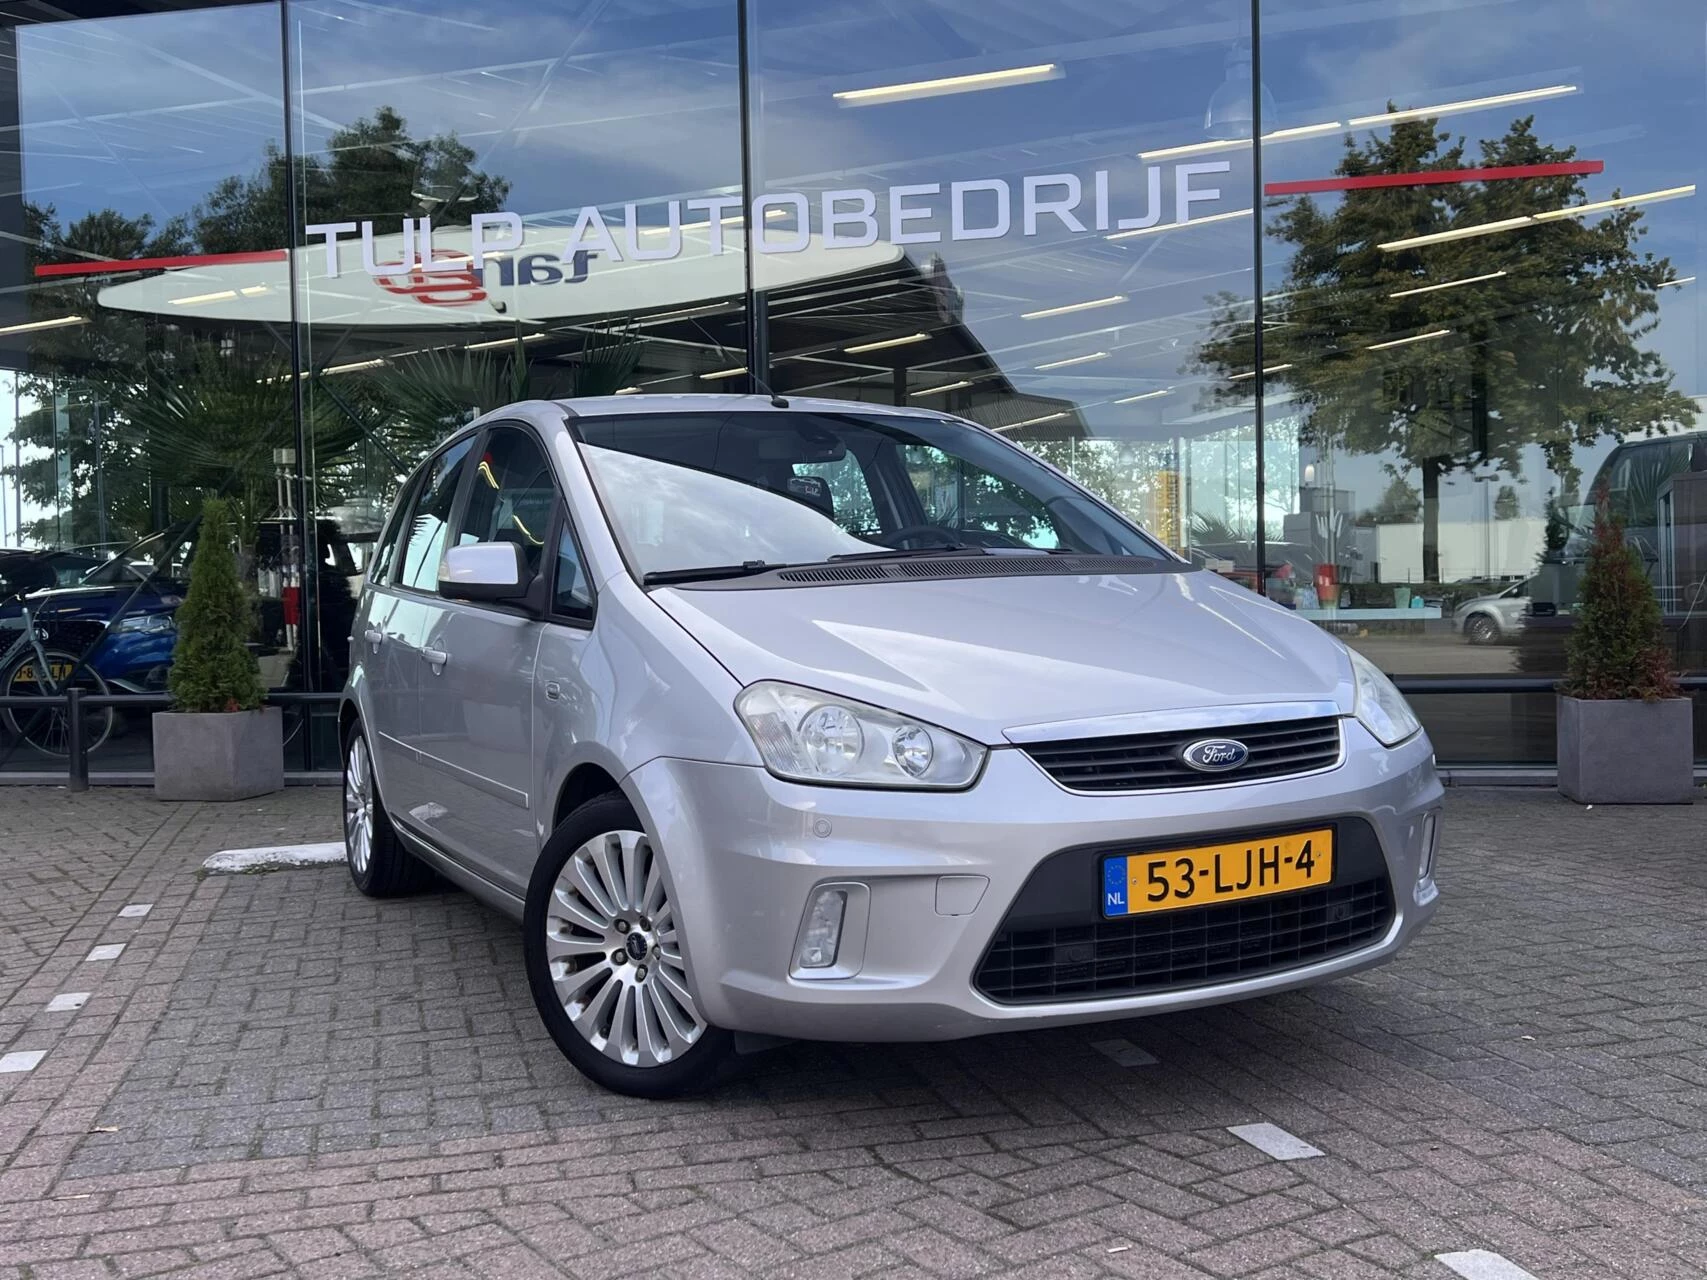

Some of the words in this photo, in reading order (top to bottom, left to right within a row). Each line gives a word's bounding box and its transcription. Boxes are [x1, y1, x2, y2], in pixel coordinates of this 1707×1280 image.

[305, 210, 526, 279] TULP
[561, 160, 1231, 263] AUTOBEDRIJF
[1202, 744, 1236, 764] Ford
[1107, 893, 1125, 906] NL
[1146, 839, 1316, 902] 53-LJH-4
